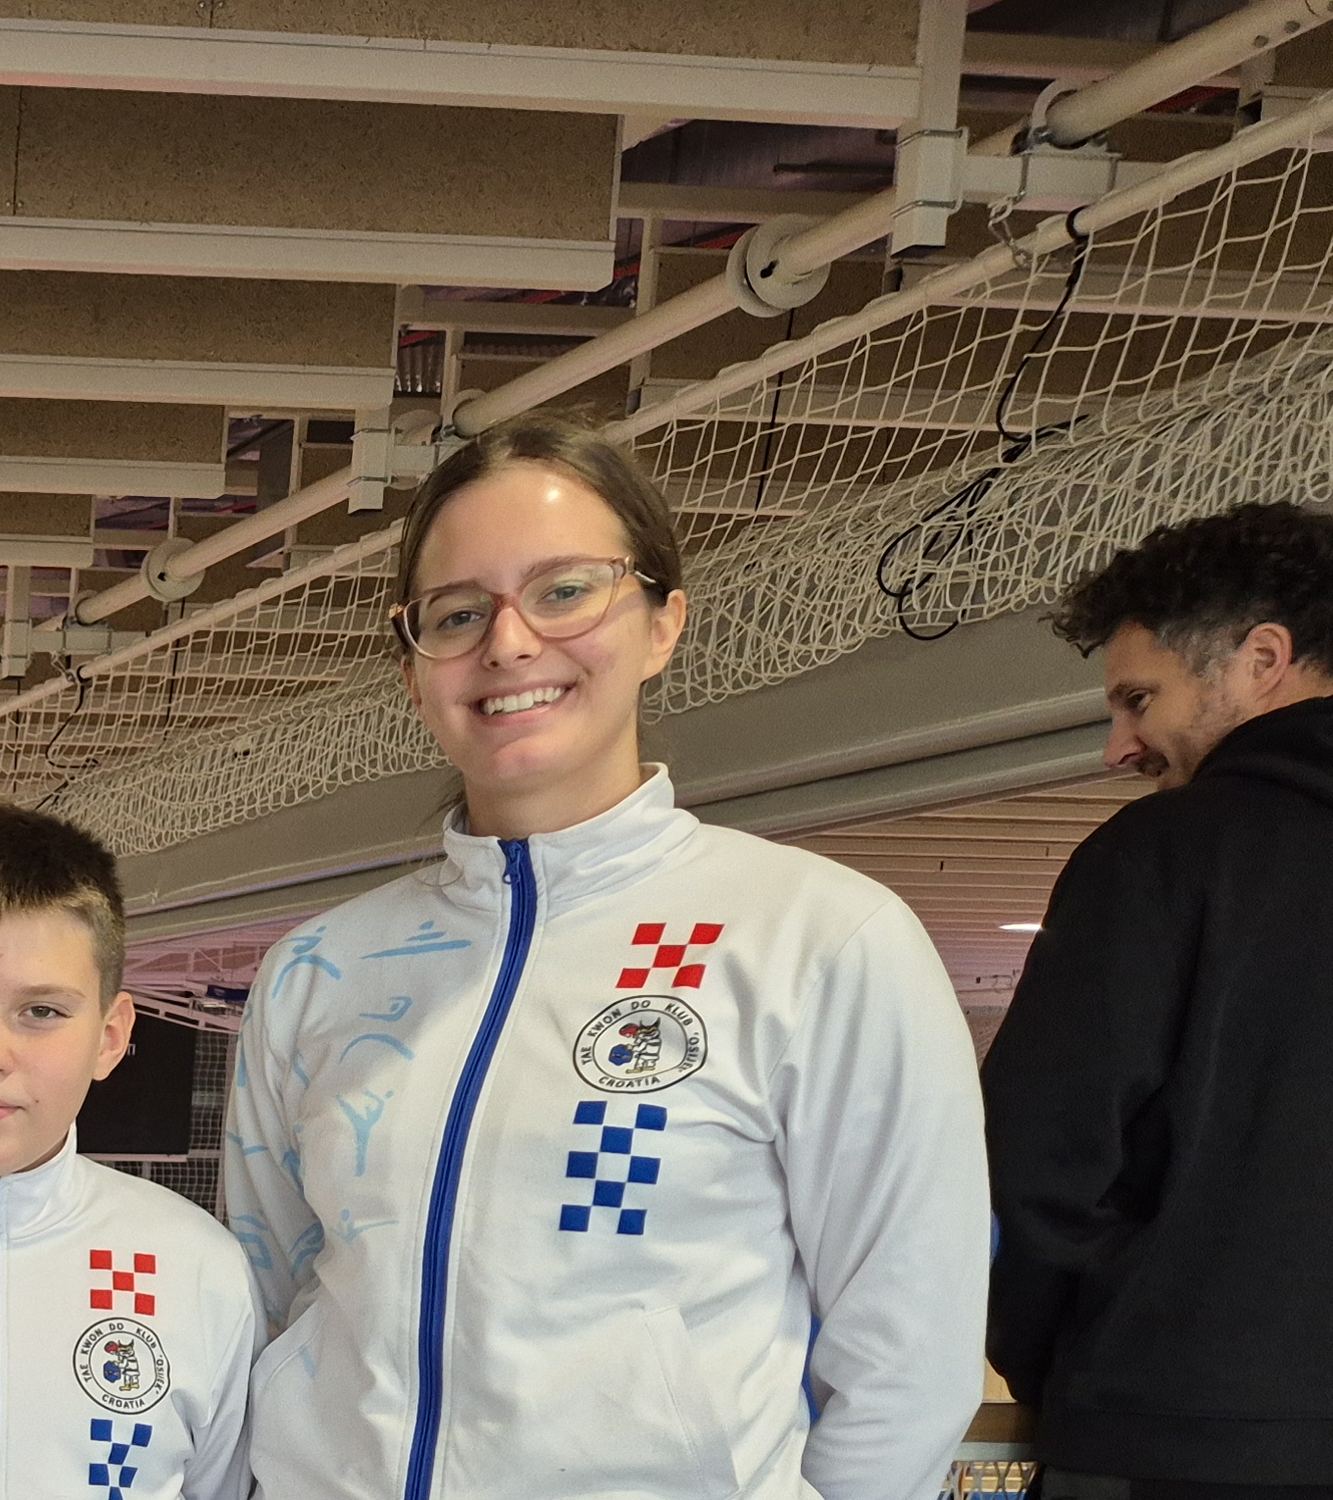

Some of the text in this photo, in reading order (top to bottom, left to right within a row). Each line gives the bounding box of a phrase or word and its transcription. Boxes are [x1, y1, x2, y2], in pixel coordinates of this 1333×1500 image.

[631, 1000, 651, 1010] DO
[586, 1008, 622, 1038] KWON
[664, 1003, 693, 1027] KLUB
[580, 1046, 593, 1065] TAE
[598, 1076, 661, 1088] CROATIA
[108, 1322, 125, 1331] DO
[80, 1328, 103, 1356] KWON
[135, 1327, 157, 1349] KLUB
[79, 1363, 93, 1383] TAE
[101, 1393, 146, 1409] CROATIA
